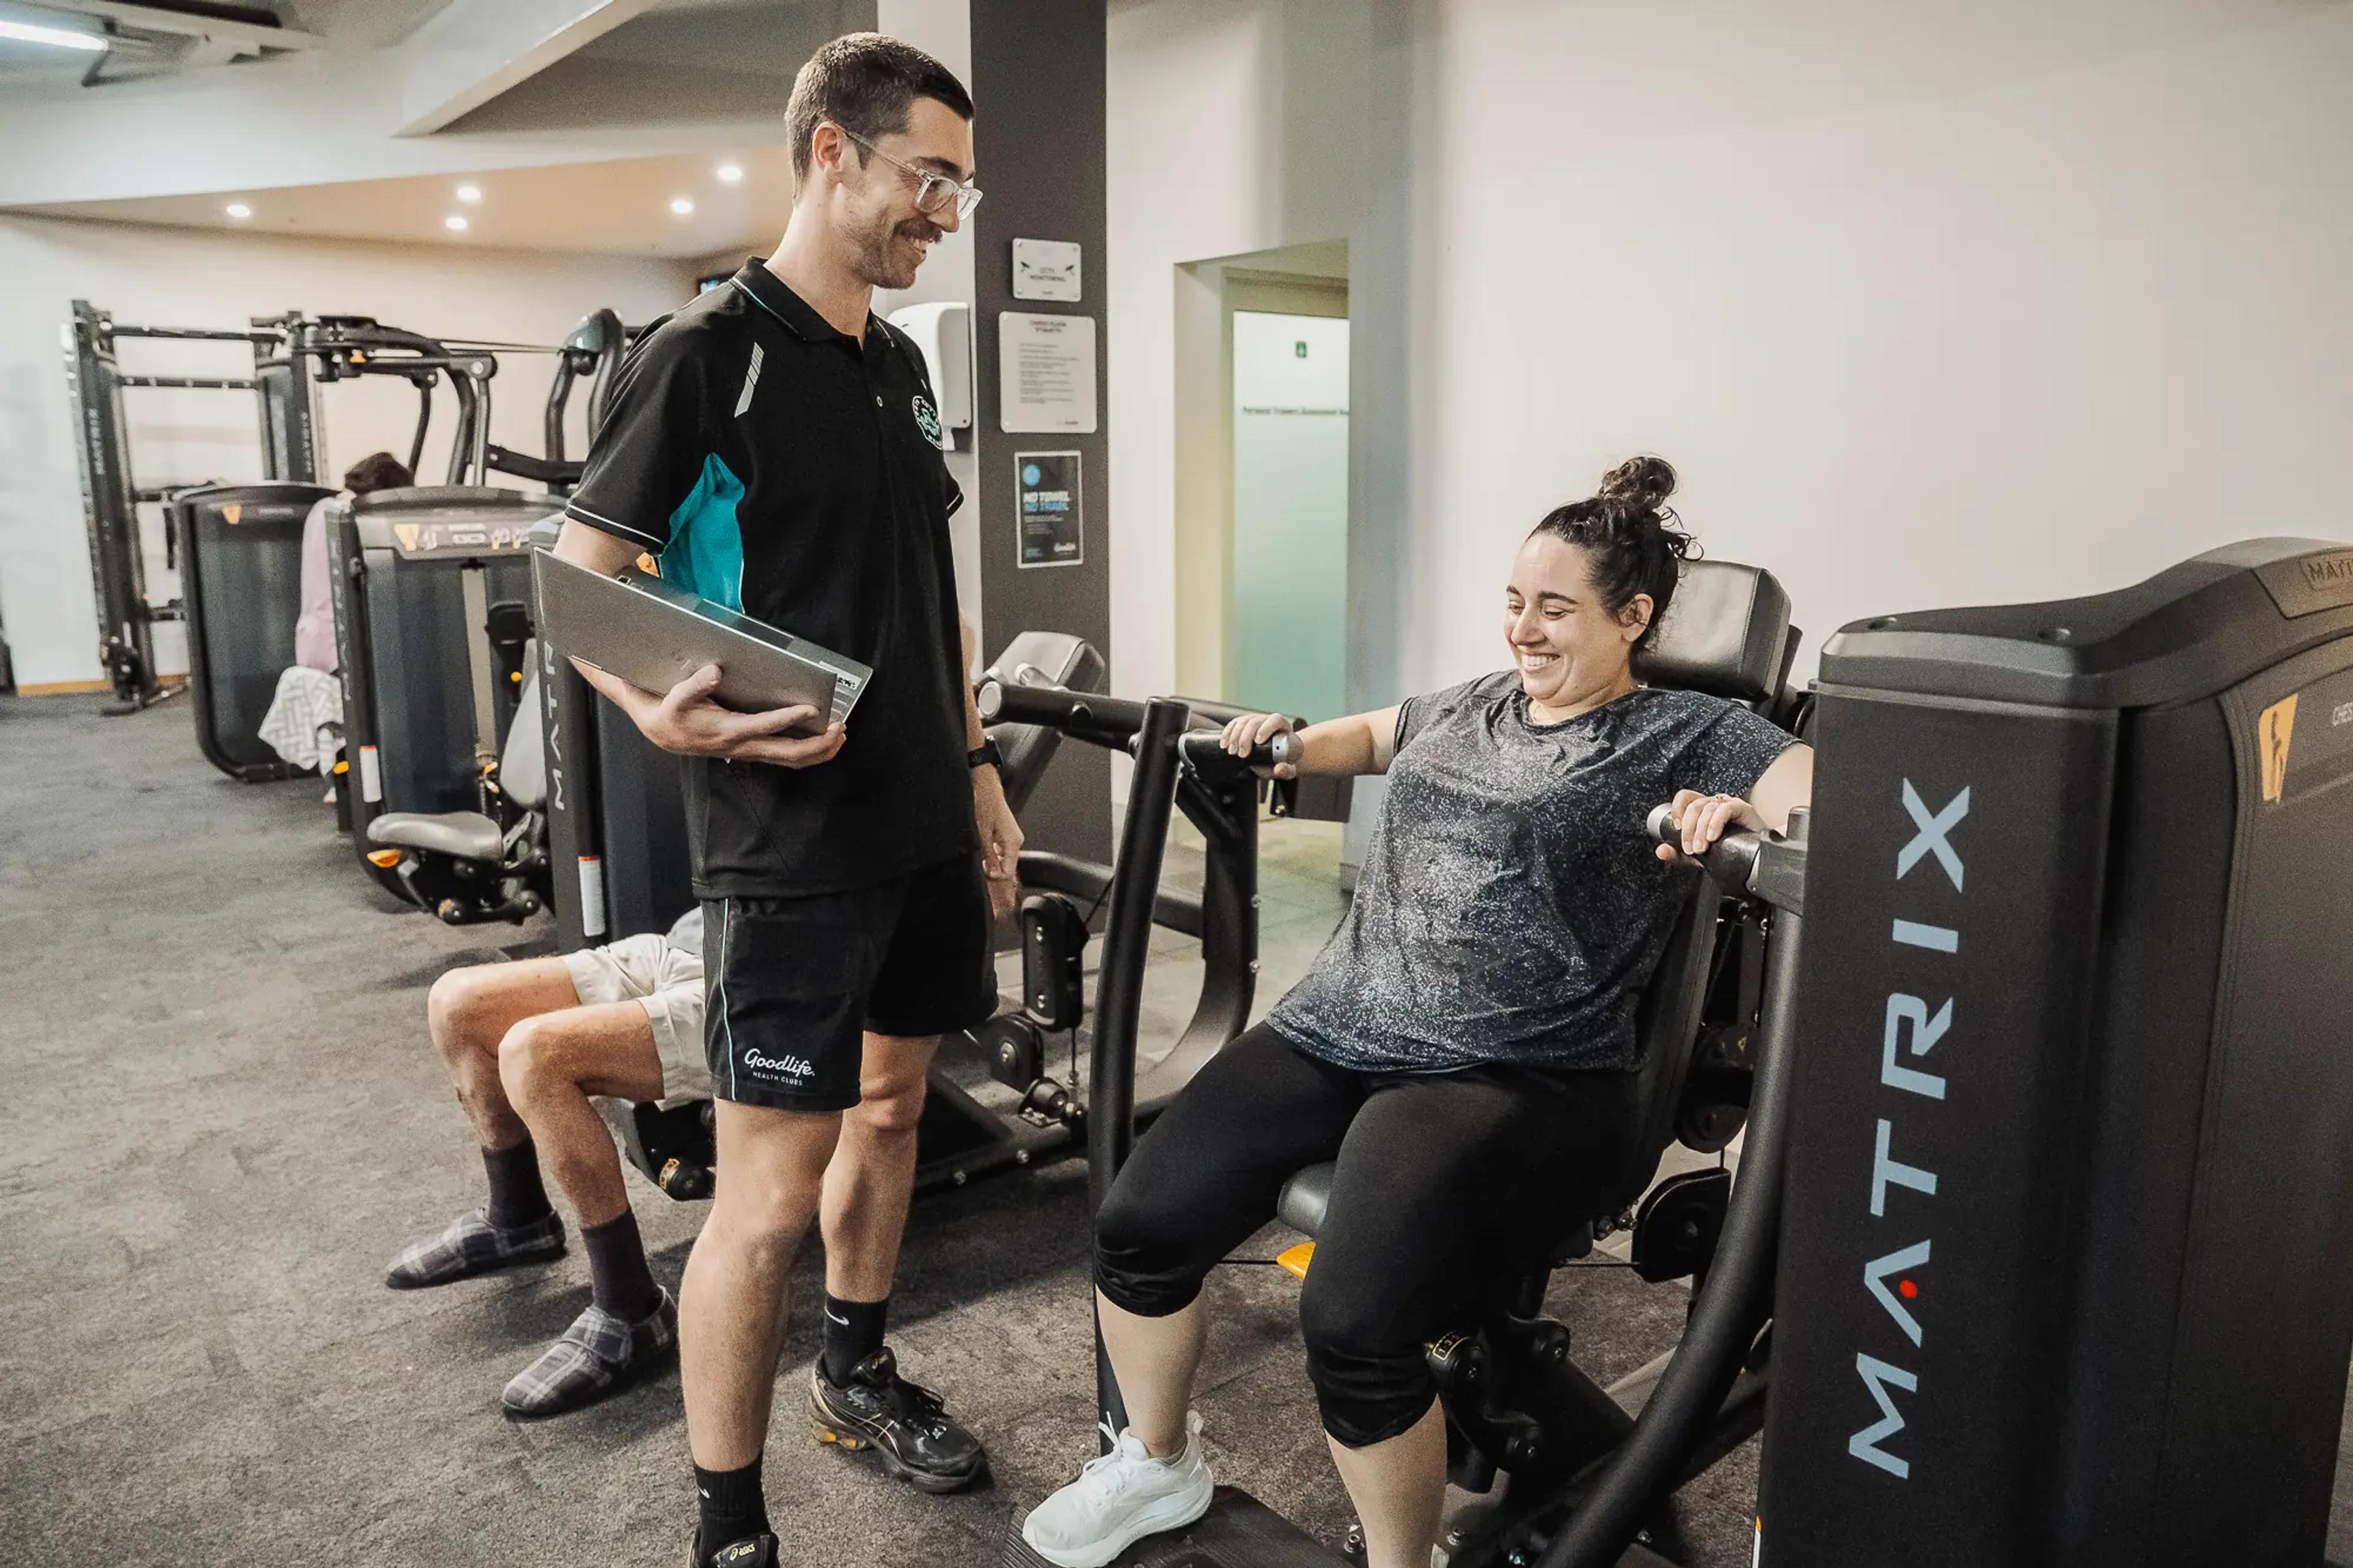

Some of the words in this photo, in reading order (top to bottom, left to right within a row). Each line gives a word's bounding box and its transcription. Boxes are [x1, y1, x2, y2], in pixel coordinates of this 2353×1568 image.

[544, 640, 564, 811] MATR
[752, 1071, 779, 1080] HEALTH
[781, 1076, 803, 1086] CLUBS
[1849, 776, 1971, 1480] MATRIX
